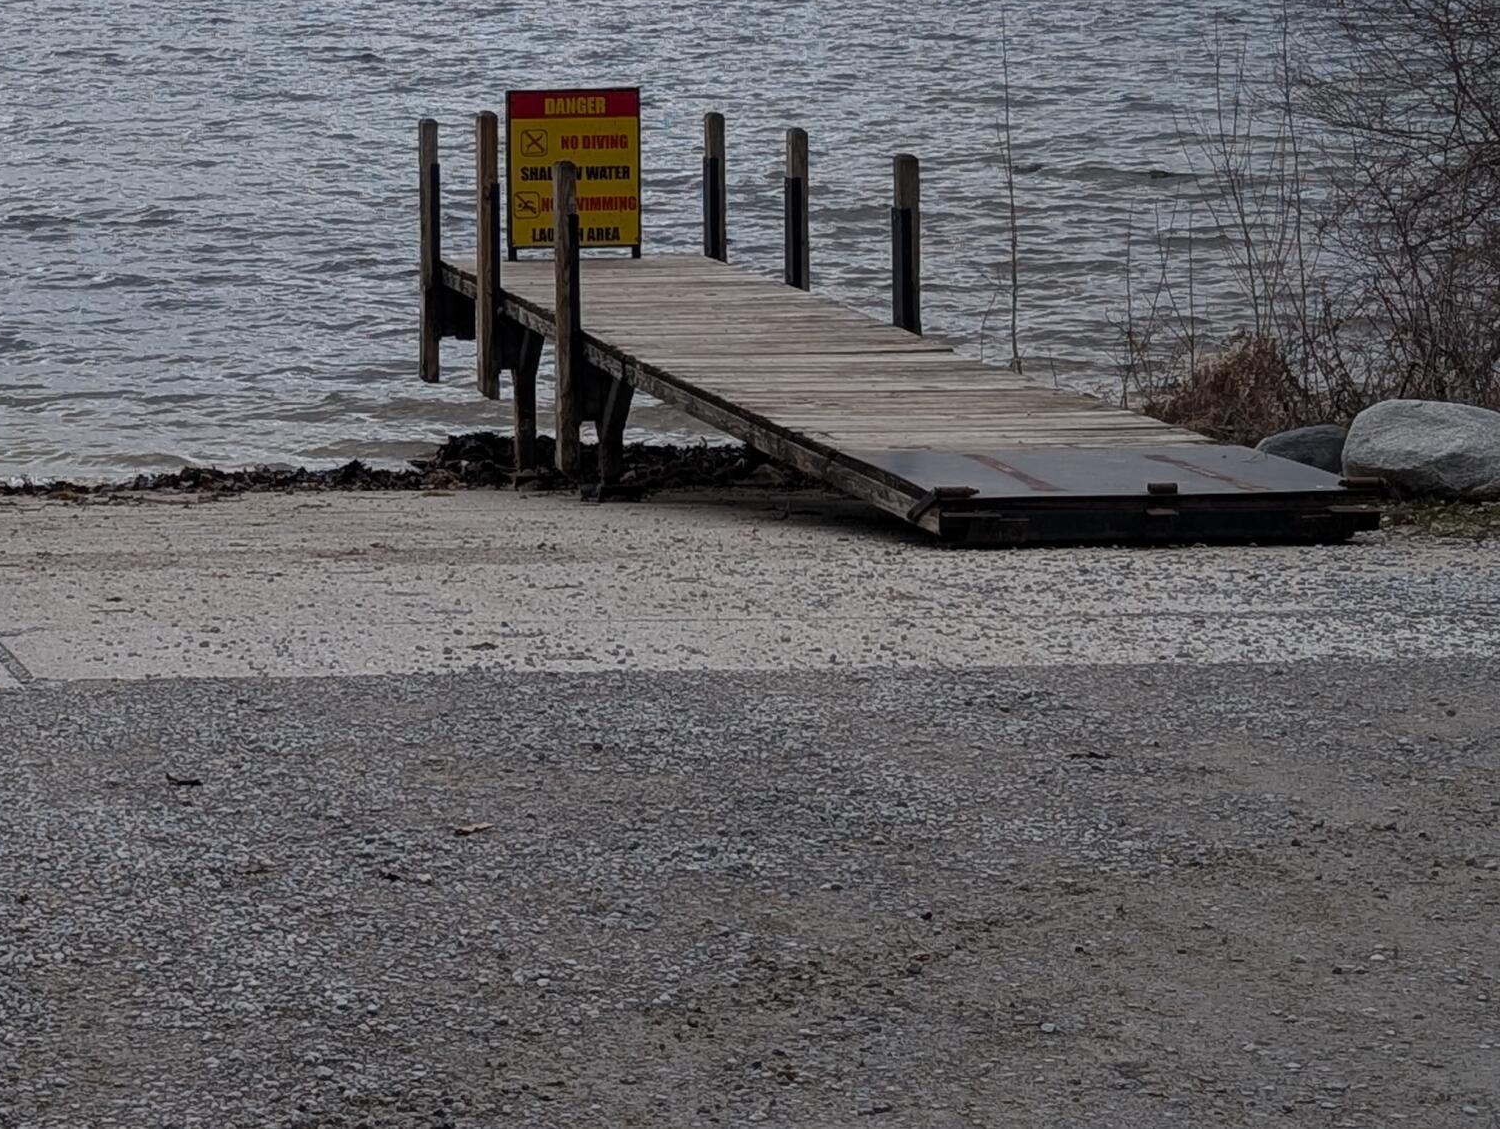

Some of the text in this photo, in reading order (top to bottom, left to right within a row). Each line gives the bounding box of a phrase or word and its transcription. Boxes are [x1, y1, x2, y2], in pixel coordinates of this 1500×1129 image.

[544, 96, 606, 115] DANGER
[561, 134, 628, 150] NO DIVING
[520, 165, 630, 181] SHALW WATER
[574, 196, 637, 212] WIMMING
[532, 227, 620, 242] LAUH AREA
